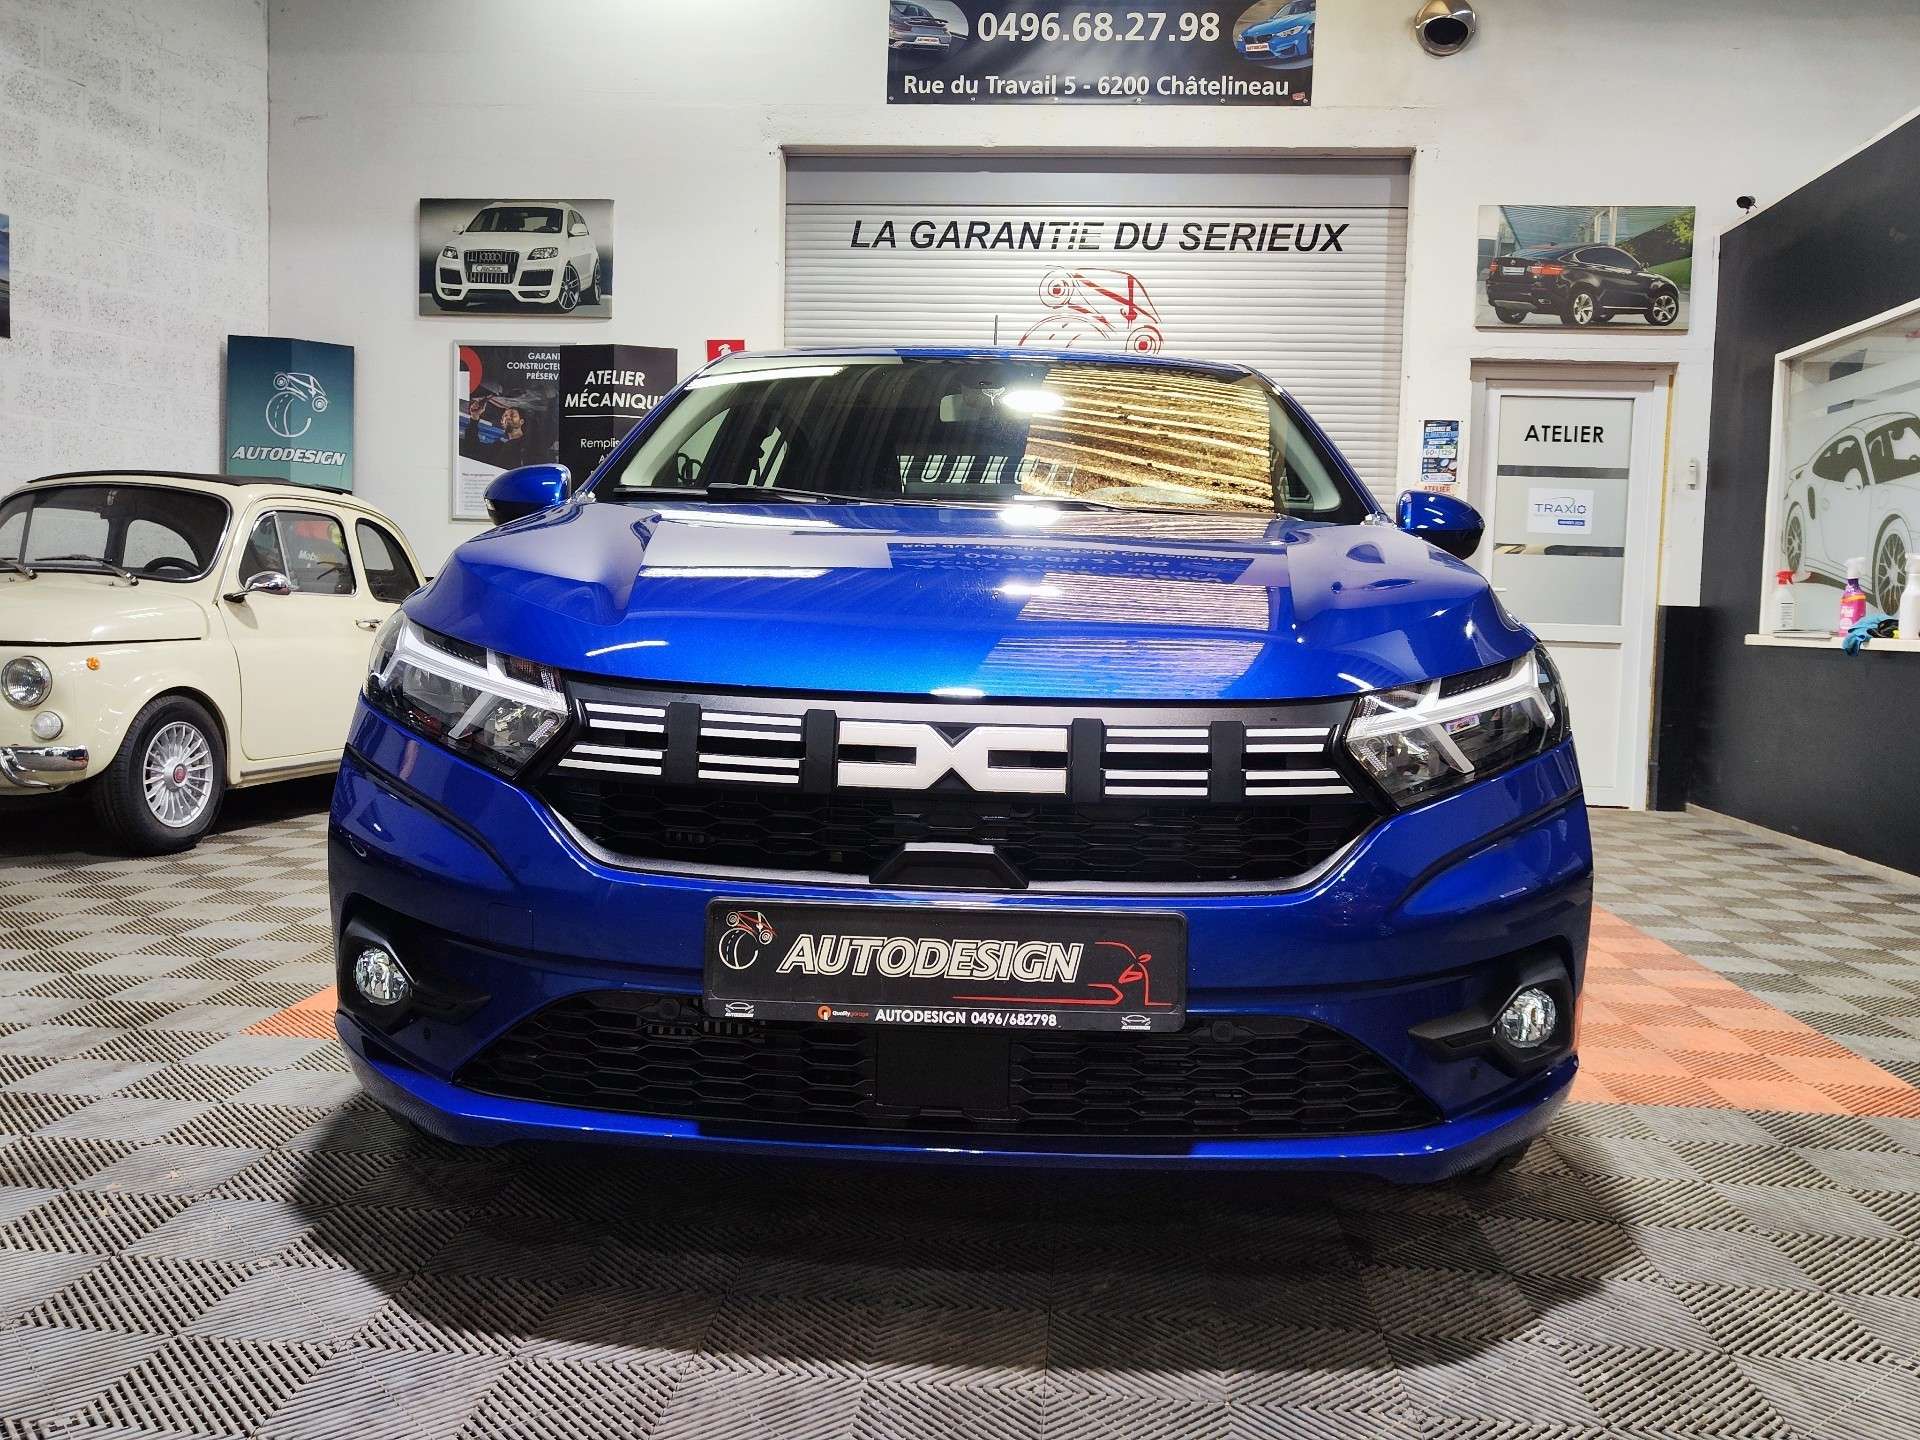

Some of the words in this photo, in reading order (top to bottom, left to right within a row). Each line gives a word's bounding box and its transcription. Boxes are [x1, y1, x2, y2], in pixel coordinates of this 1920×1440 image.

[977, 12, 1220, 42] 0496.68.27.98
[904, 75, 945, 95] Rue
[951, 74, 979, 95] du
[985, 75, 1057, 95] Travail
[1064, 75, 1076, 95] 5
[1097, 76, 1150, 95] 6200
[1156, 75, 1289, 96] Châtelineau
[851, 220, 897, 249] LA
[910, 220, 1105, 250] GARANTIE
[1113, 222, 1169, 251] DU
[1178, 222, 1350, 252] SERIEUX
[585, 369, 646, 387] ATELIER
[1524, 424, 1604, 443] ATELIER
[232, 446, 345, 466] AUTODESIGN
[1534, 503, 1587, 514] TRAXIO
[776, 933, 1085, 983] AUTODESIGN
[875, 1008, 966, 1025] AUTODESIGN
[970, 1011, 1057, 1027] 0496/682798
